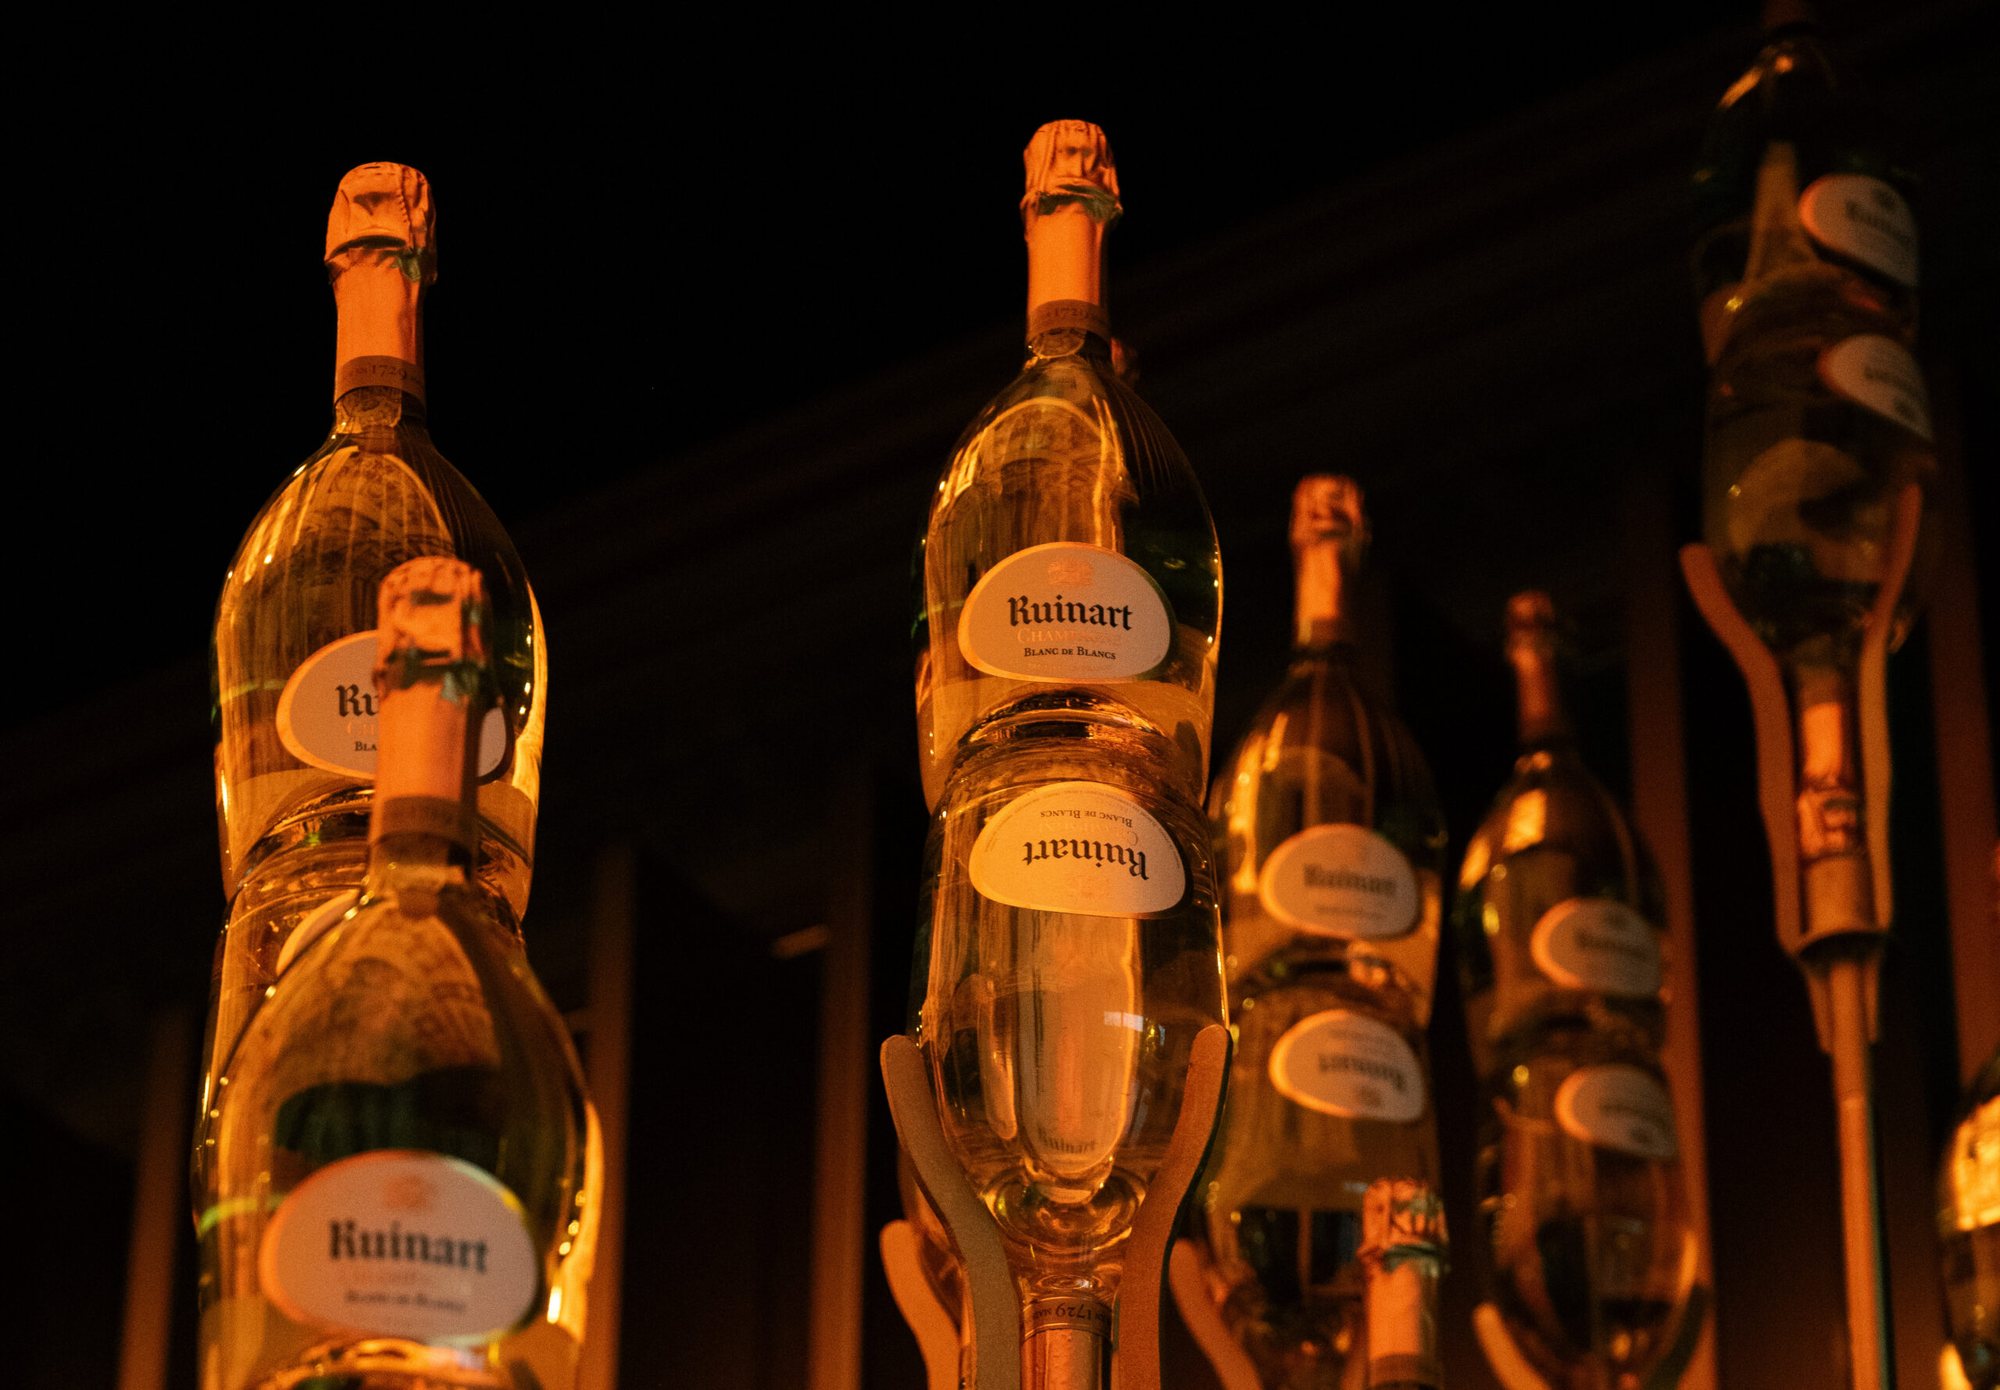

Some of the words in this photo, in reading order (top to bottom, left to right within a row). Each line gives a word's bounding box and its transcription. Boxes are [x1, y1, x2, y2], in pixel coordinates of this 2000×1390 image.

[1007, 594, 1133, 631] Ruinart
[1024, 647, 1059, 657] BLANC
[1061, 648, 1074, 656] DE
[1077, 646, 1116, 660] BLANCS
[354, 741, 377, 751] BLA
[1040, 809, 1081, 819] BLANCS
[1085, 810, 1097, 818] DE
[1099, 812, 1133, 828] BLANC
[1022, 838, 1150, 881] Ruinart
[327, 1217, 488, 1275] Ruinart
[1055, 1302, 1092, 1320] 1729
